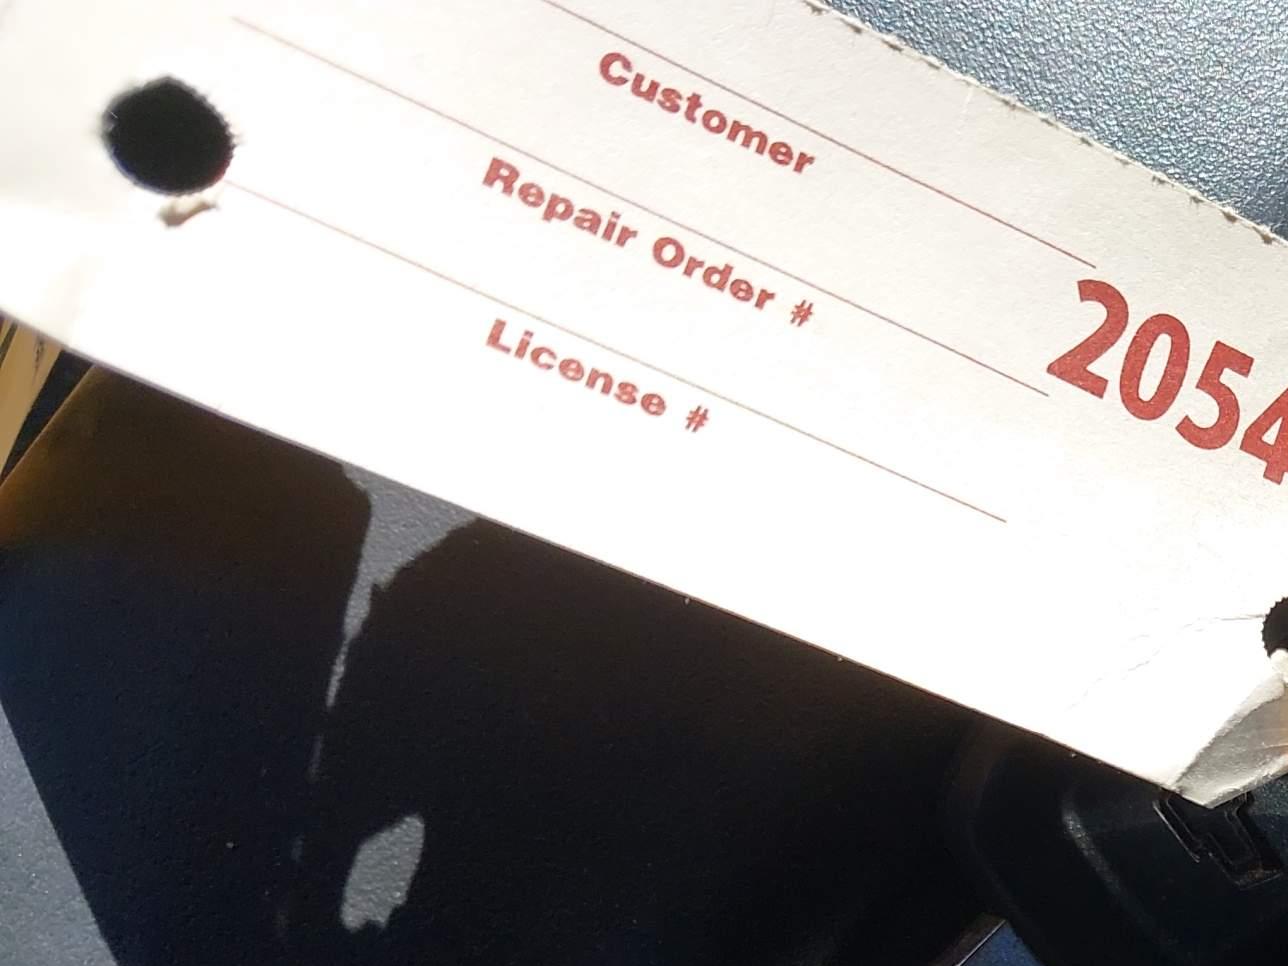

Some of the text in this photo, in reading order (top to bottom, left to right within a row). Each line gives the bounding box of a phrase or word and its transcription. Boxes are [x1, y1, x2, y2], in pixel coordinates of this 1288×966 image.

[598, 51, 815, 174] Customer
[482, 158, 814, 327] Repair Order #
[486, 319, 709, 431] License #
